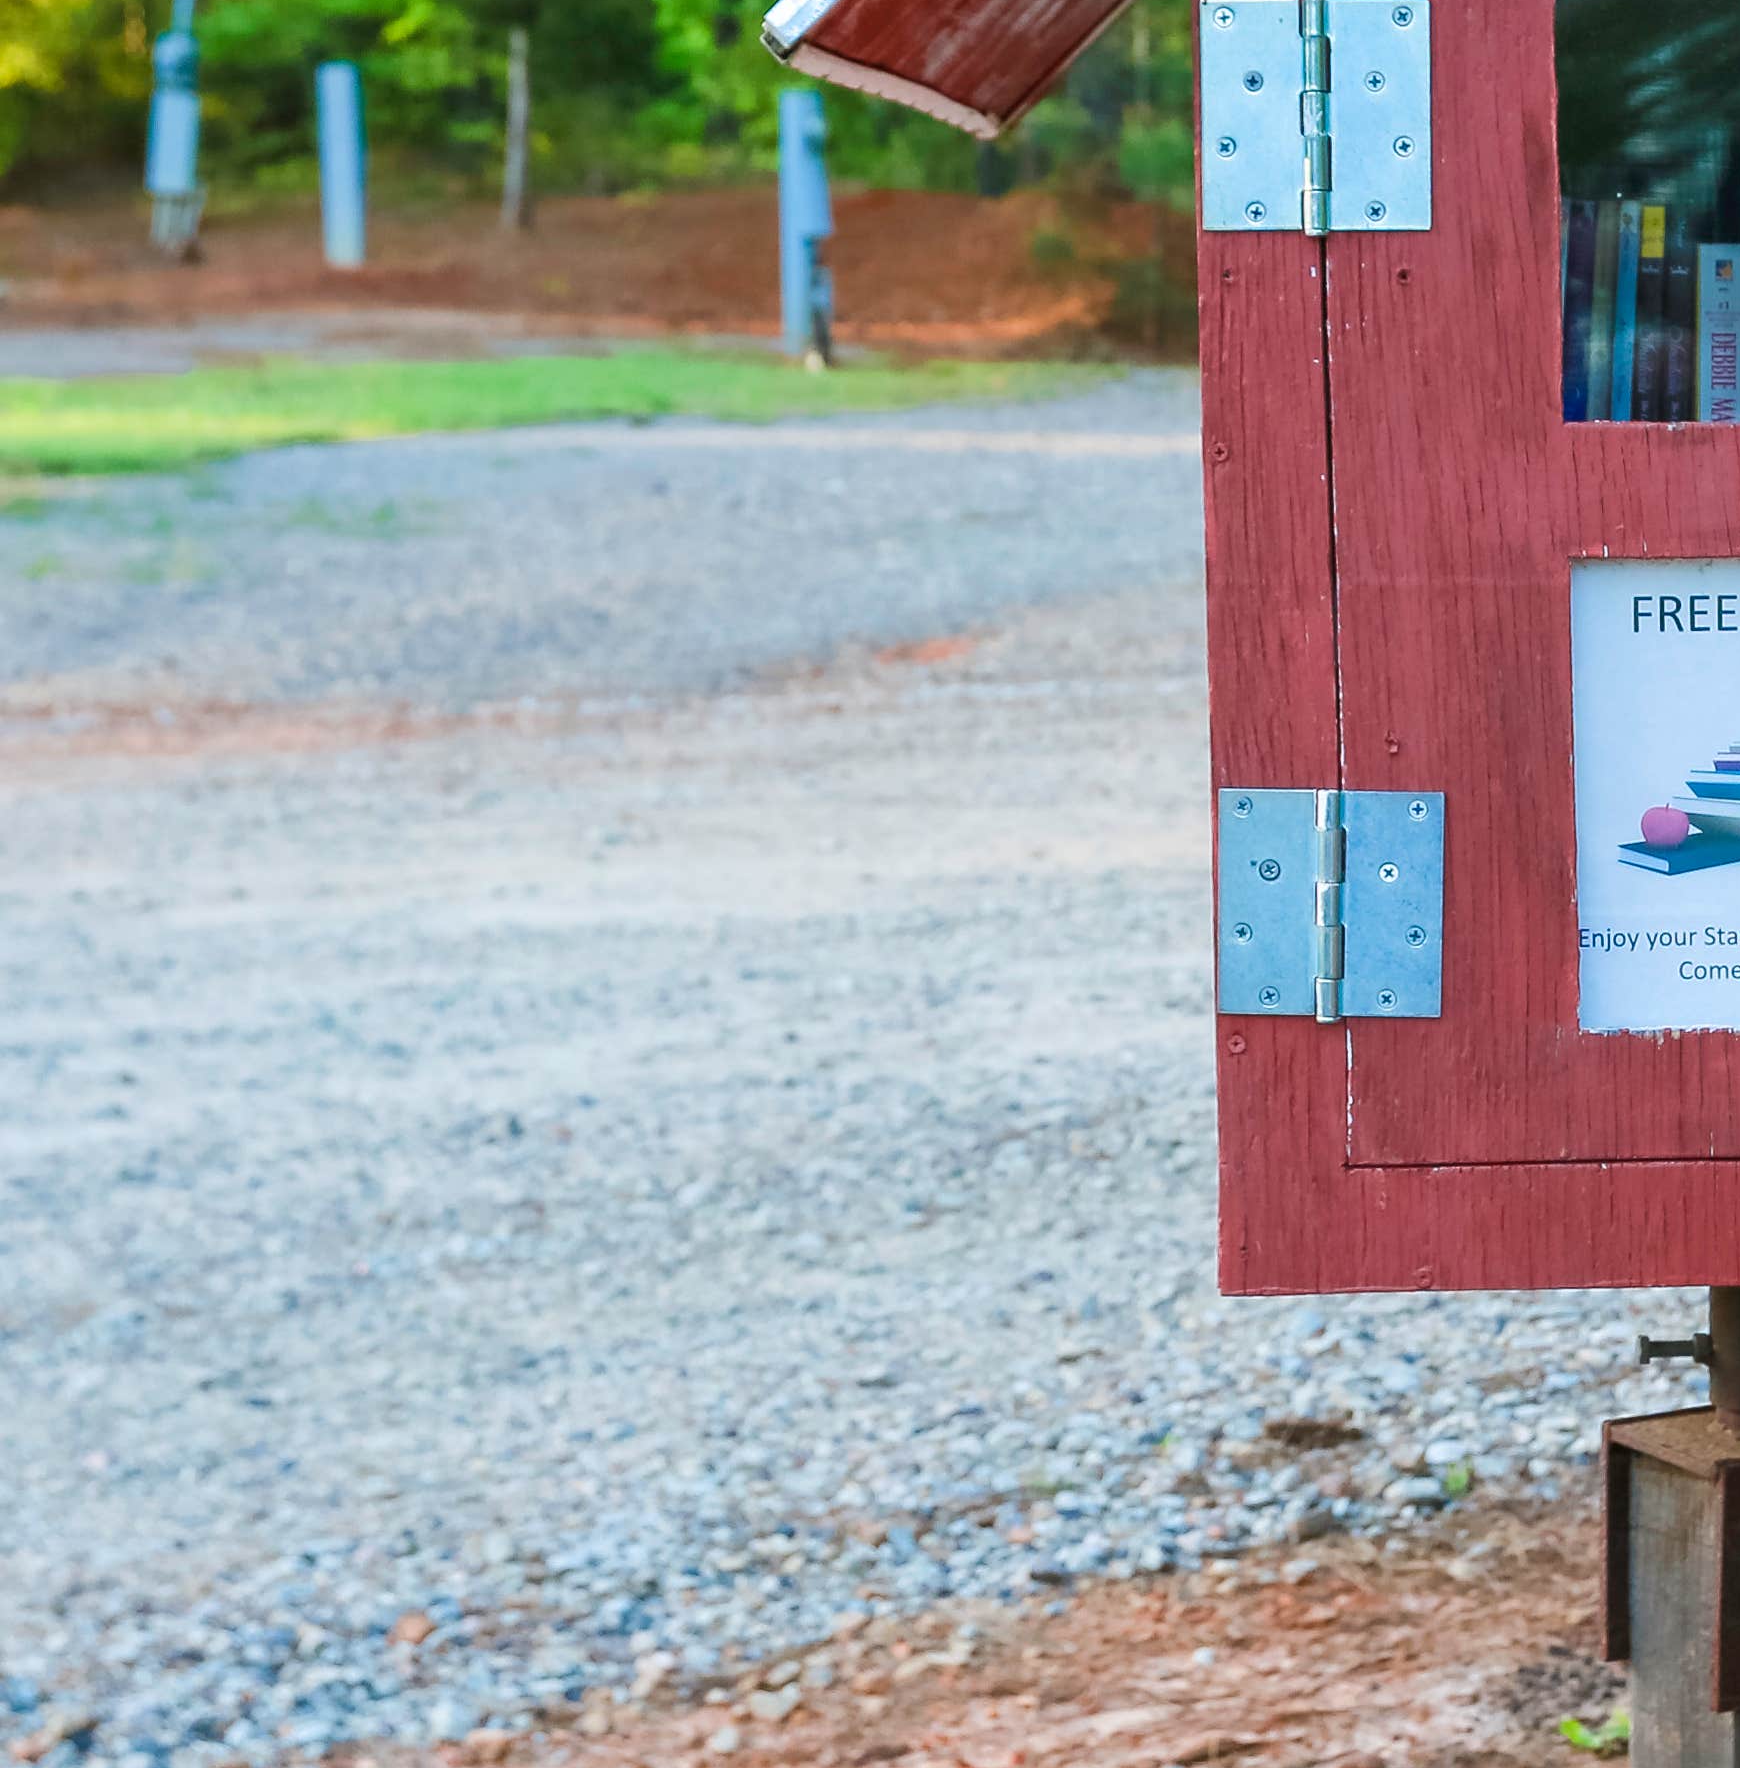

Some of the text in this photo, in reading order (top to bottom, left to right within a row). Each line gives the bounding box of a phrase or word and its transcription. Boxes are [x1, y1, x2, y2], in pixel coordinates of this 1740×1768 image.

[1711, 332, 1738, 391] DEBBIE
[1632, 594, 1739, 634] FREE
[1578, 927, 1638, 952] Enjoy
[1645, 931, 1698, 950] your
